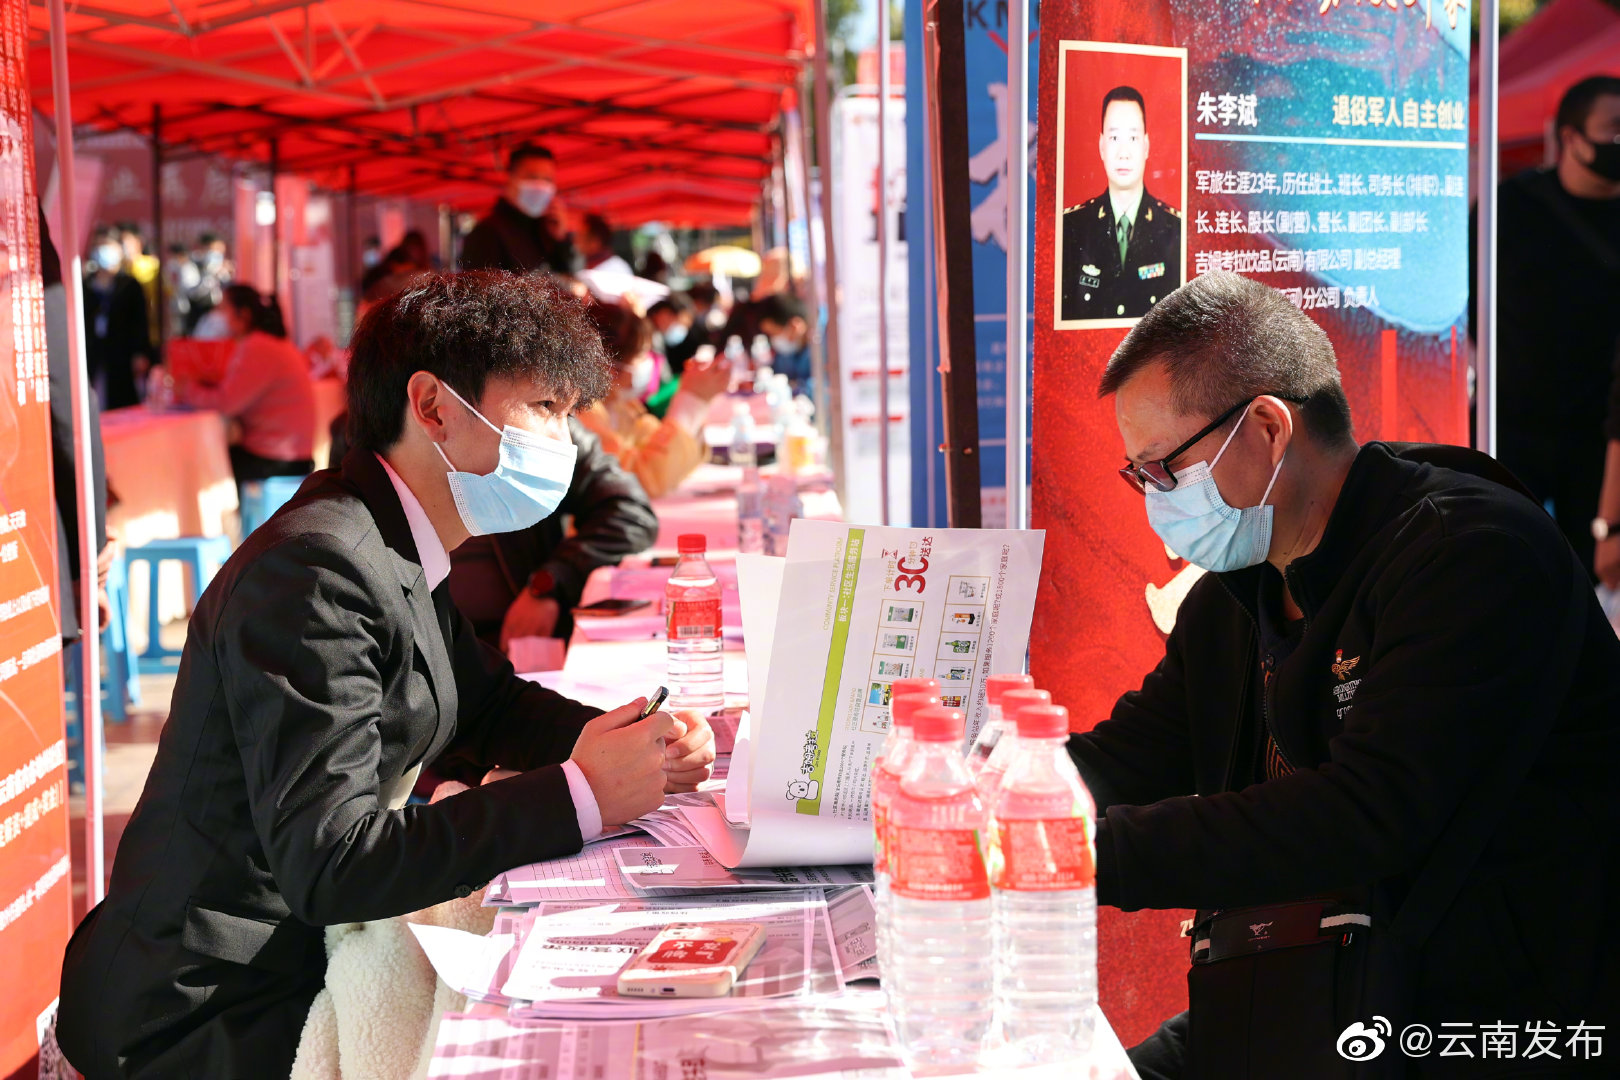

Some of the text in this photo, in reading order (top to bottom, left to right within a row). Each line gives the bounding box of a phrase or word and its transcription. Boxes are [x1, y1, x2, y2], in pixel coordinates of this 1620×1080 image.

[1196, 91, 1258, 127] 朱李斌
[1332, 94, 1466, 130] 退役军人自主创业
[1343, 284, 1380, 308] 负责人
[919, 536, 933, 558] 送达
